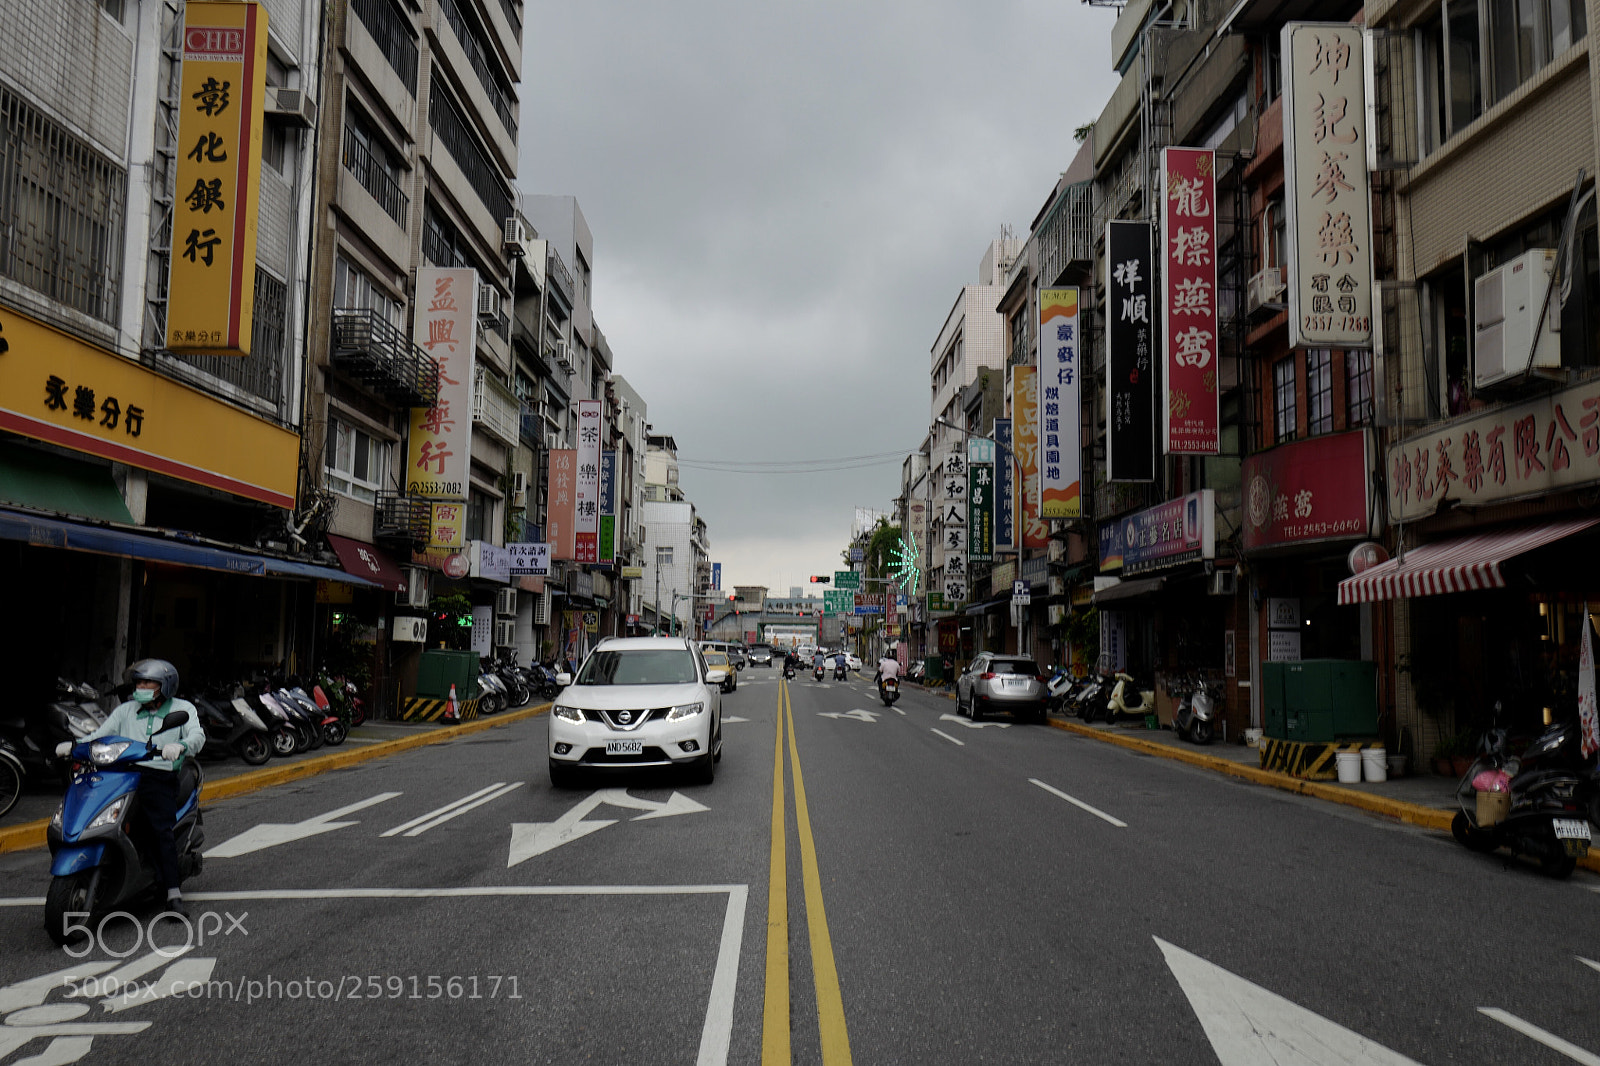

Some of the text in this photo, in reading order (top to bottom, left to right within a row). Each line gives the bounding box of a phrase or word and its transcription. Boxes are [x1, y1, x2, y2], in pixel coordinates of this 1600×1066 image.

[187, 31, 241, 50] CHB
[182, 77, 231, 267] 彰化銀行
[1170, 177, 1213, 369] 龍標燕窩
[1113, 259, 1149, 325] 祥順
[172, 330, 222, 342] 永樂分行
[44, 375, 145, 437] 永樂分行
[420, 481, 462, 494] 2553-7082
[1272, 489, 1313, 523] 燕窩
[941, 633, 956, 646] 70
